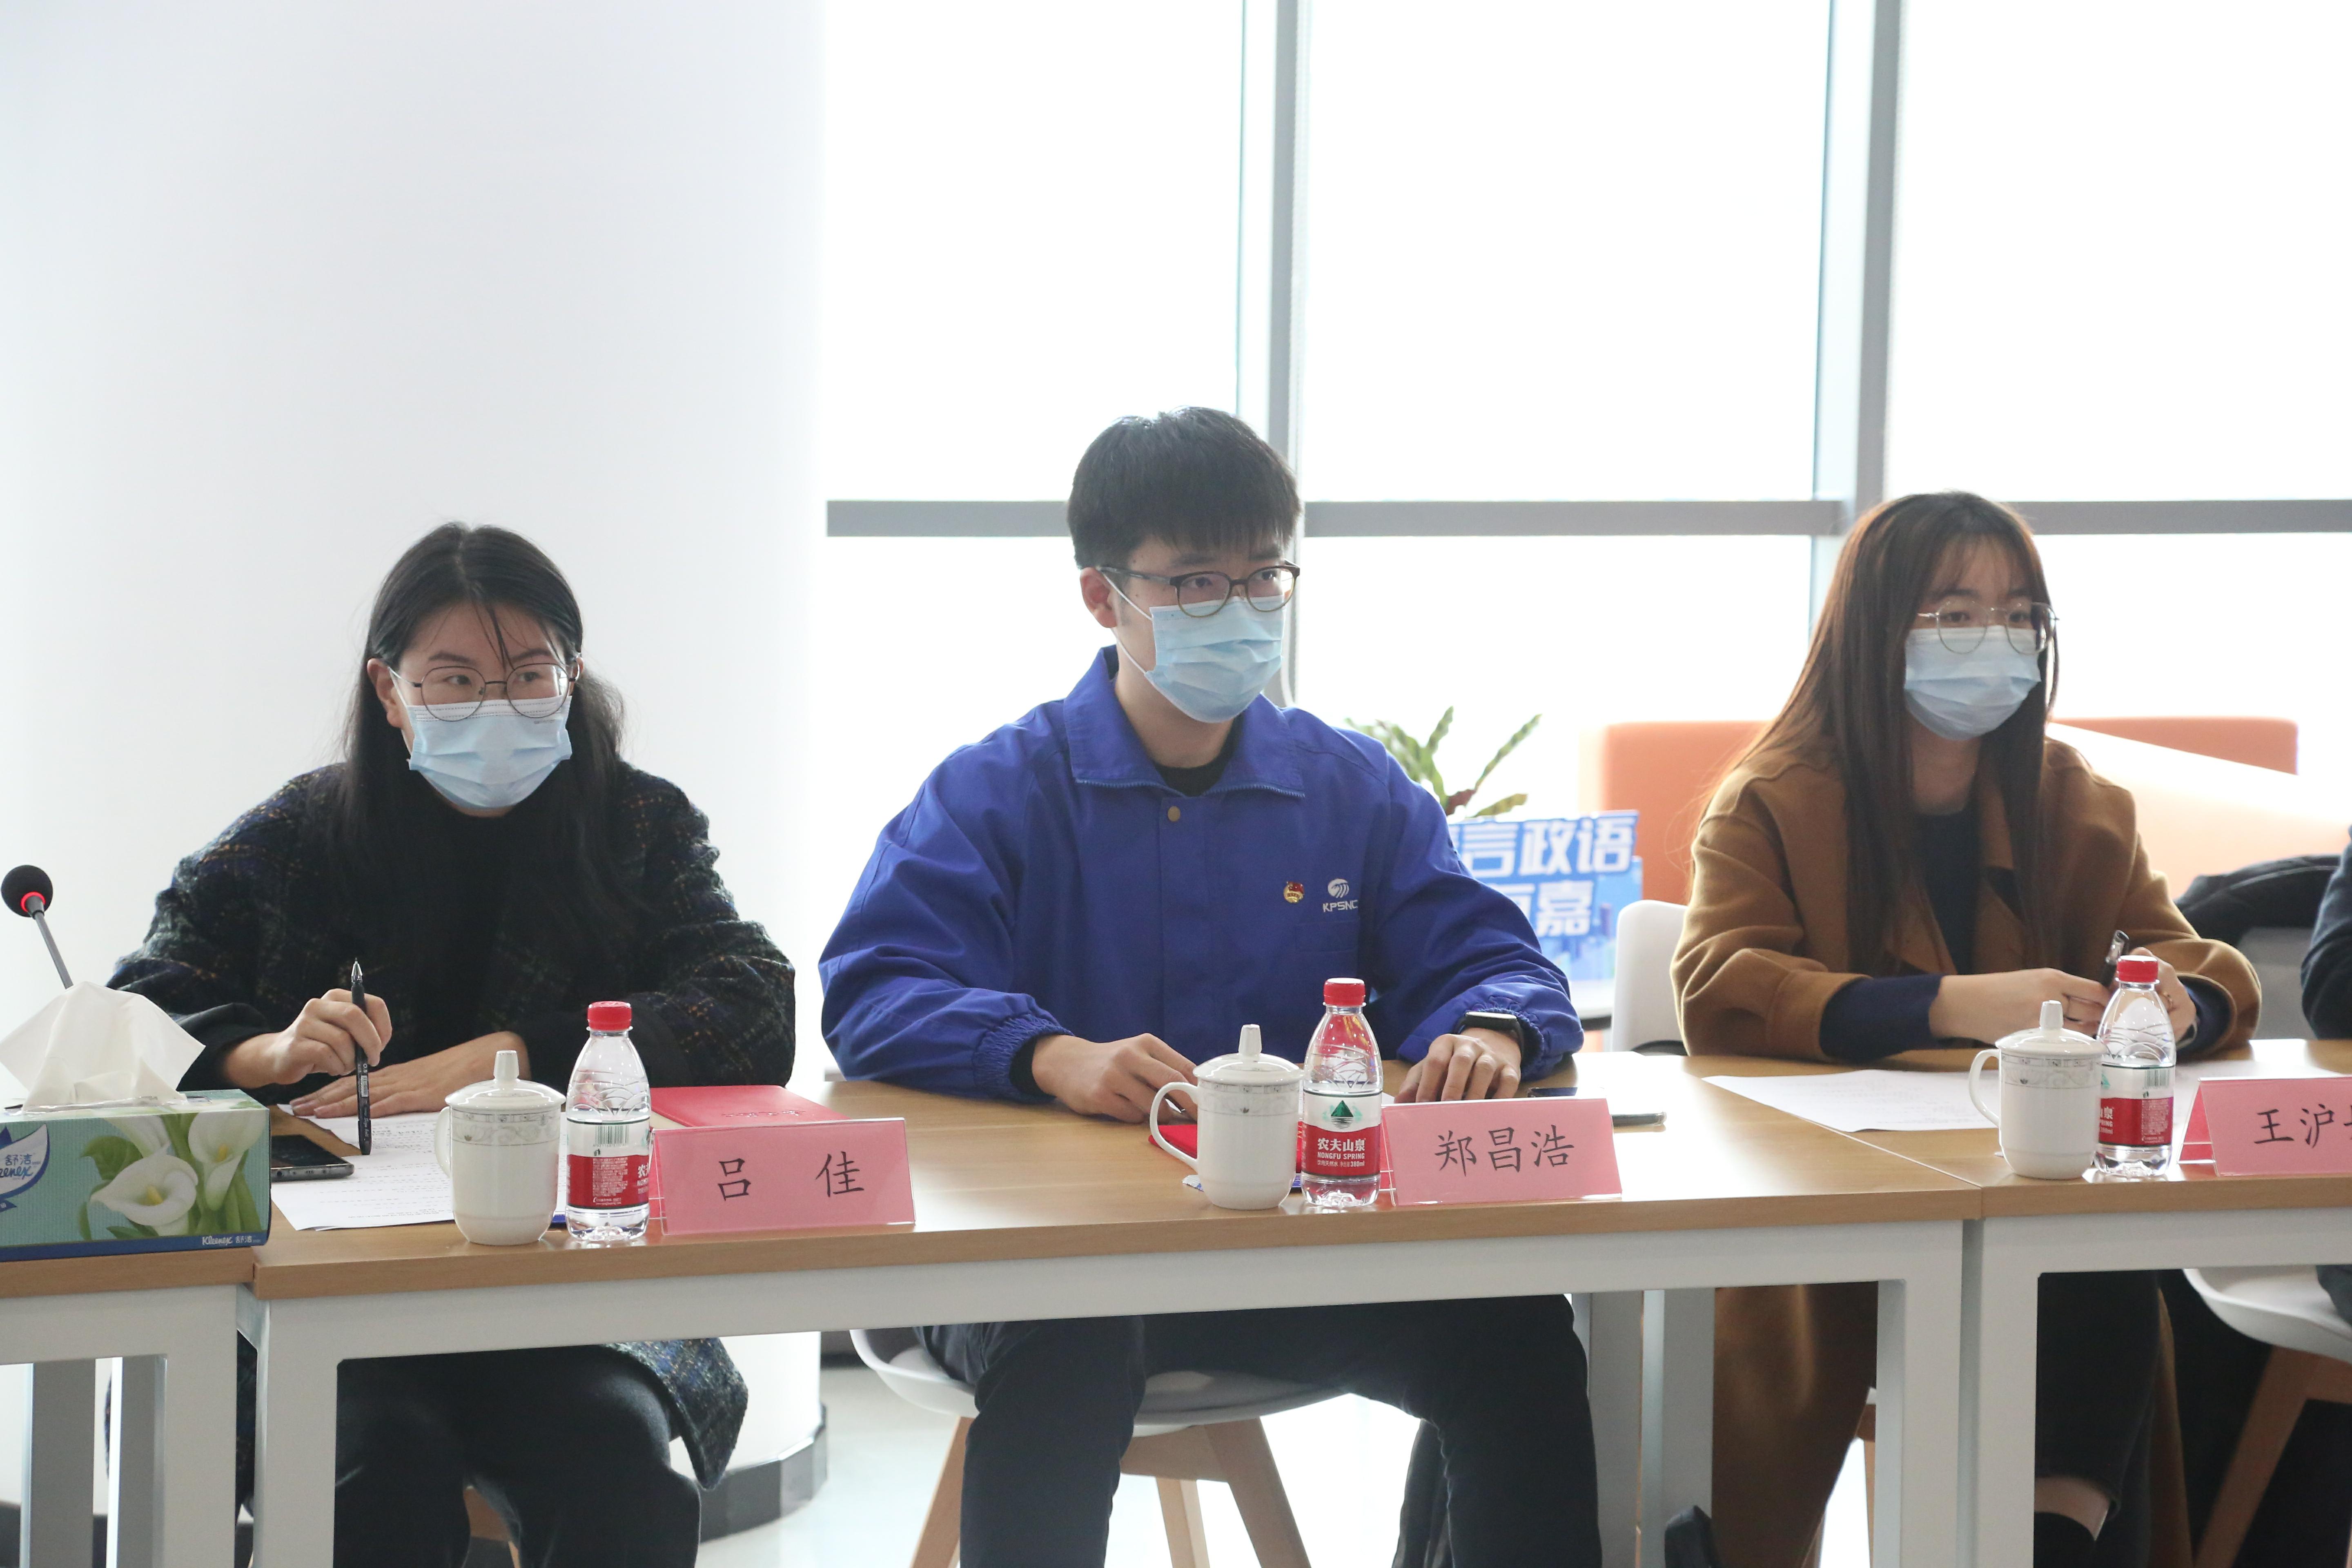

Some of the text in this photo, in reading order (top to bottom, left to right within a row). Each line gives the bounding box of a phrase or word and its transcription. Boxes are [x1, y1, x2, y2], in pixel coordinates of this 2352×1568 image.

[1449, 817, 1636, 877] 言政语
[1322, 900, 1359, 912] KPSNC
[2254, 1104, 2352, 1148] 王沪
[1317, 1138, 1365, 1152] 农夫山泉
[1434, 1124, 1575, 1177] 郑昌浩
[5, 1154, 32, 1166] 舒洁
[202, 1236, 233, 1245] Kleenex
